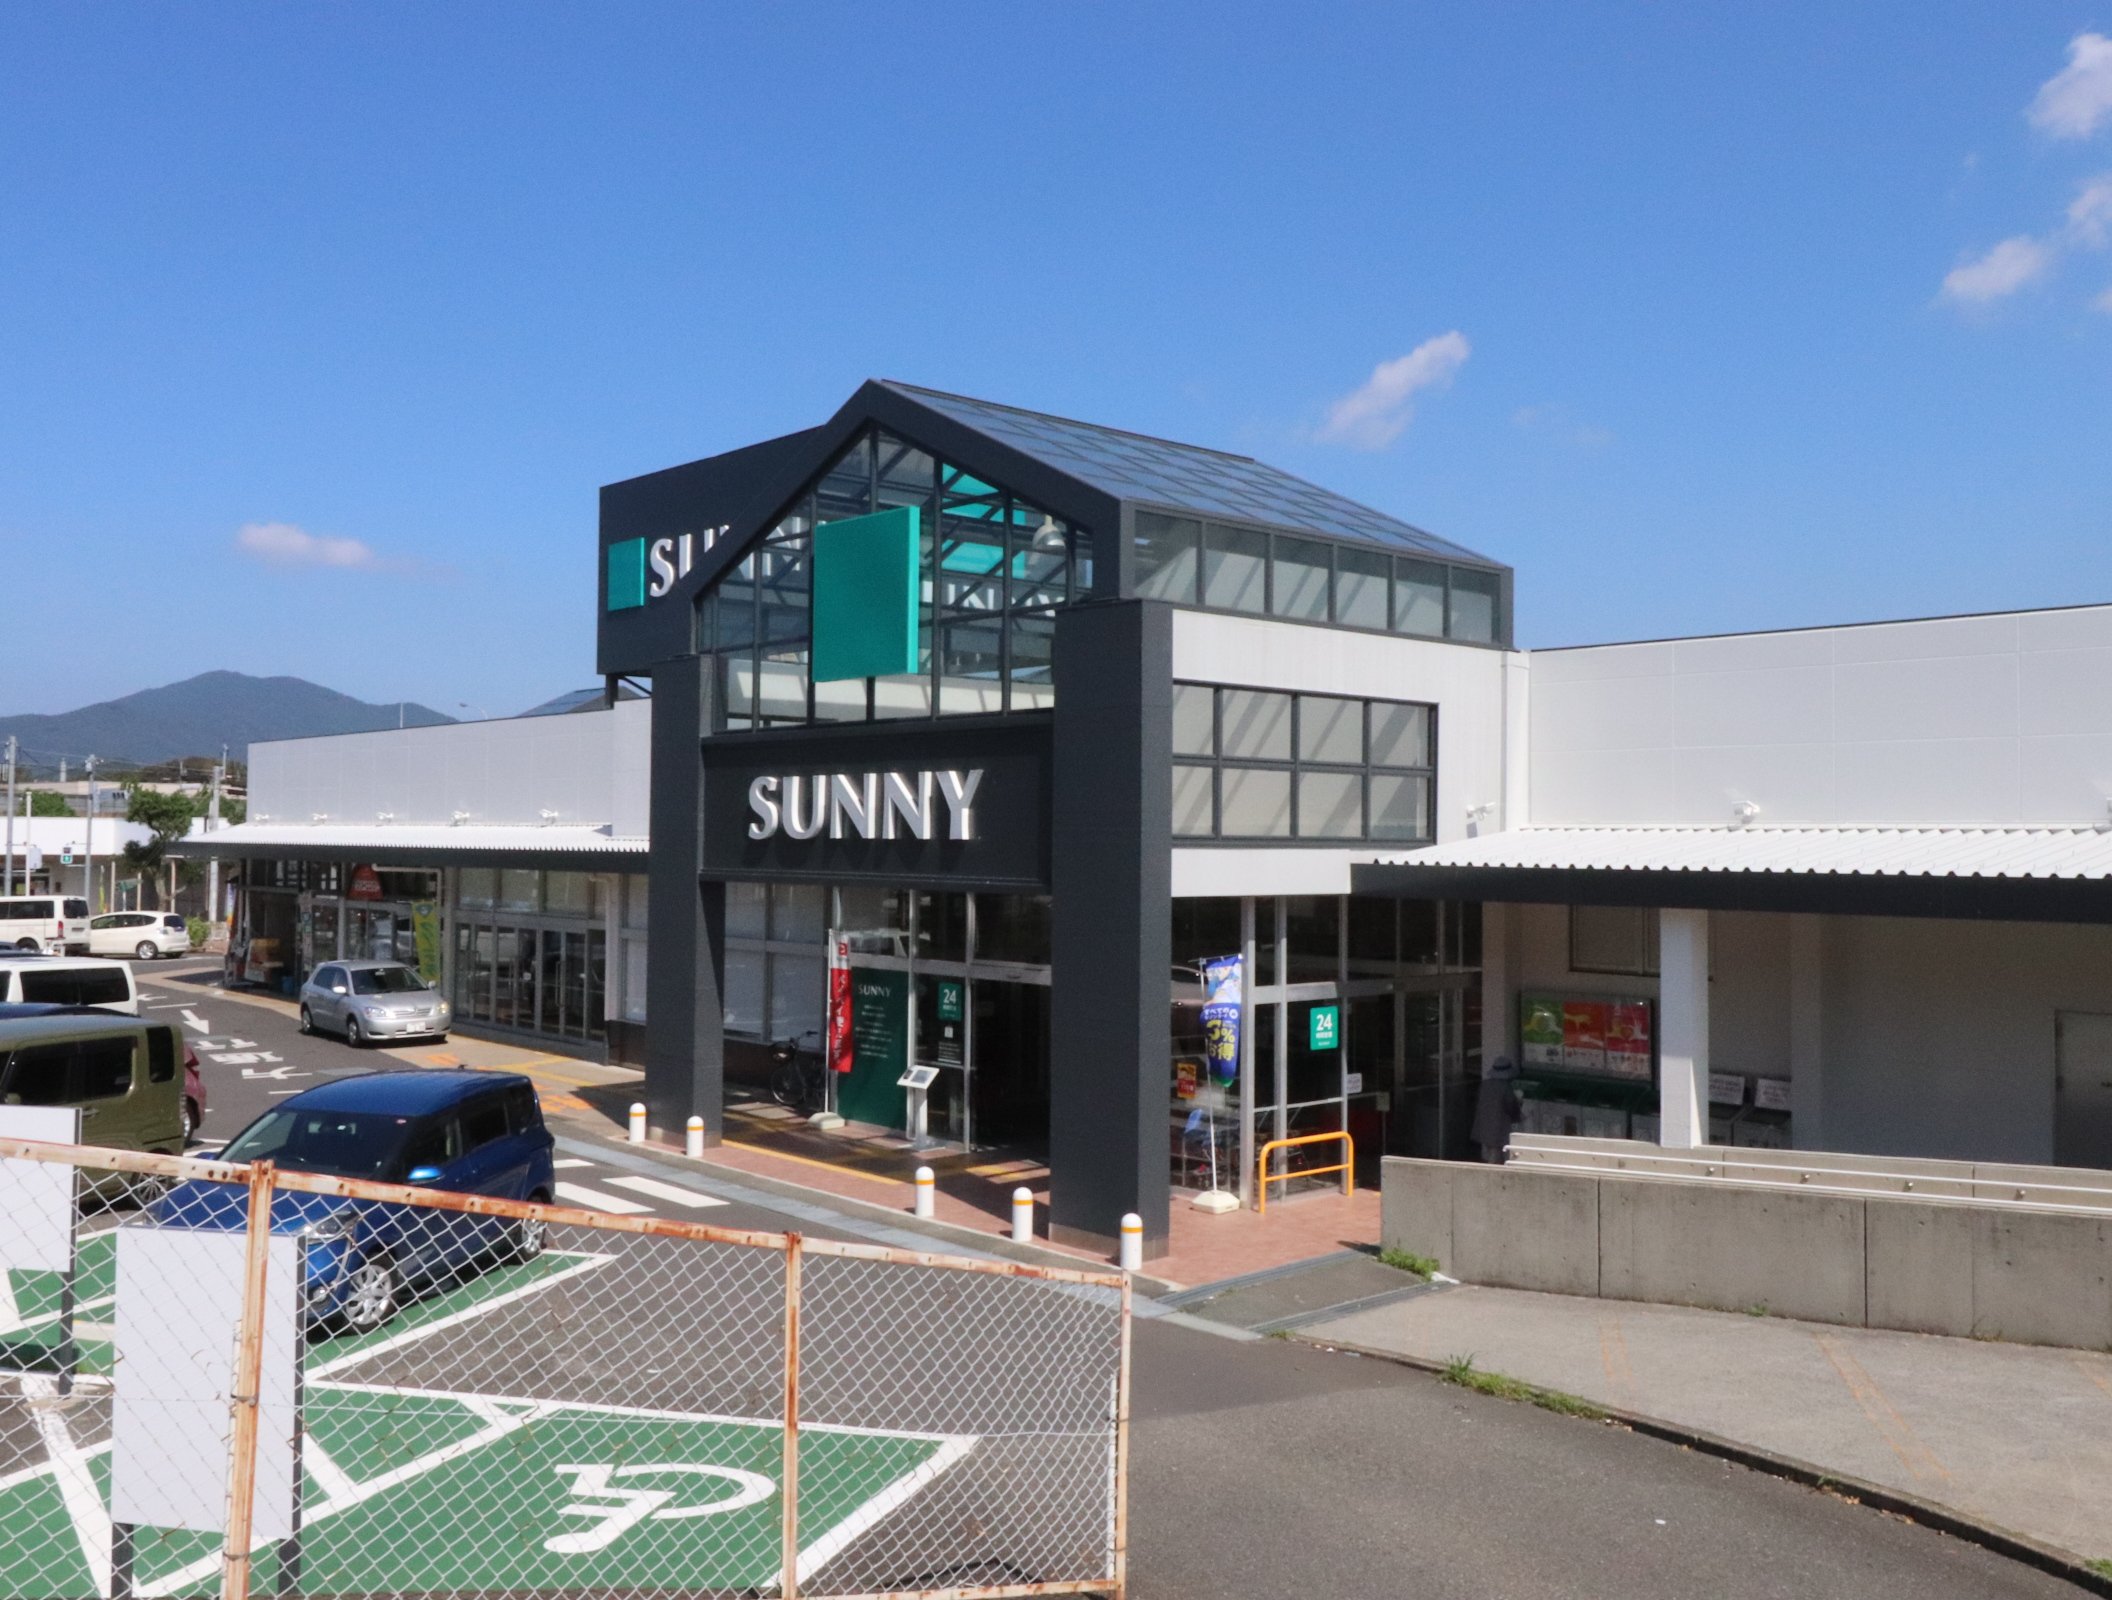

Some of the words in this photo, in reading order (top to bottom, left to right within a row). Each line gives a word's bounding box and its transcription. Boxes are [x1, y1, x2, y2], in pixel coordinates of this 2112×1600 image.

[748, 769, 984, 840] SUNNY
[857, 984, 891, 997] SUNNY
[943, 988, 956, 1004] 24
[1316, 1013, 1333, 1031] 24
[1208, 1042, 1236, 1062] お得
